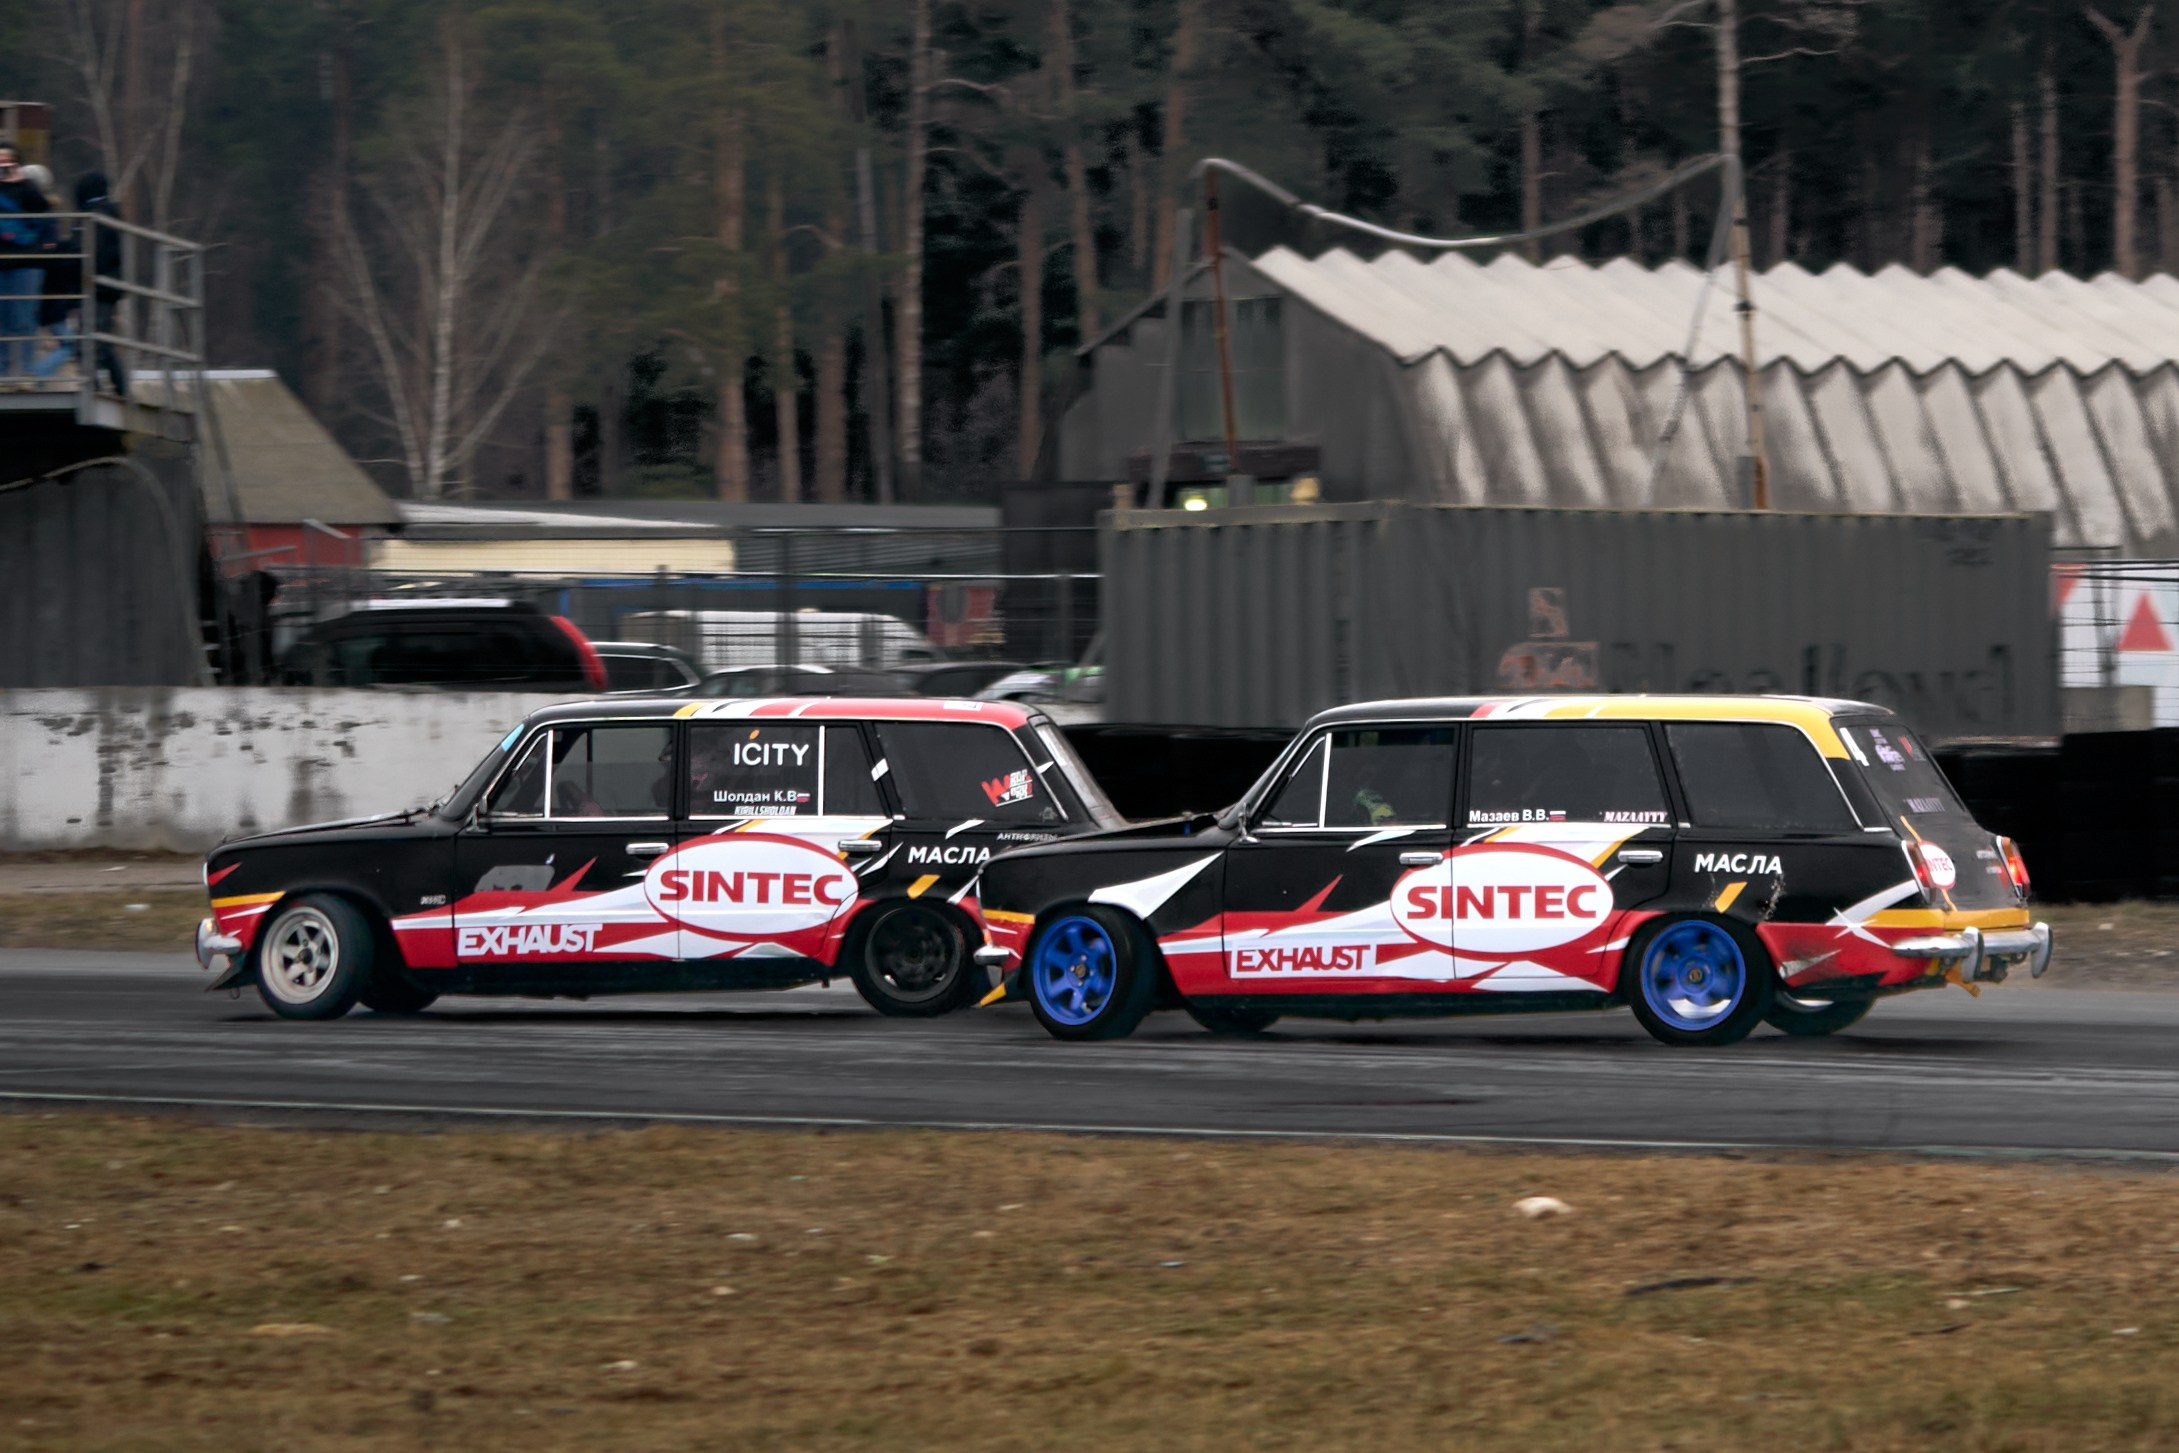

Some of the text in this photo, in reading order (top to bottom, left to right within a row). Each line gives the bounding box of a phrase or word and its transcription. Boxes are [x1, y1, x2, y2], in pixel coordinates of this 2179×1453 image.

[734, 743, 809, 766] ICITY
[714, 790, 770, 803] Шолдан
[1469, 809, 1550, 822] Мазаев В.В.
[908, 846, 990, 865] МАСЛА
[1695, 853, 1782, 874] МАСЛА
[660, 870, 843, 905] SINTEC
[1407, 885, 1597, 920] SINTEC
[457, 923, 603, 957] EXHAUST
[1236, 944, 1372, 973] EXHAUST
